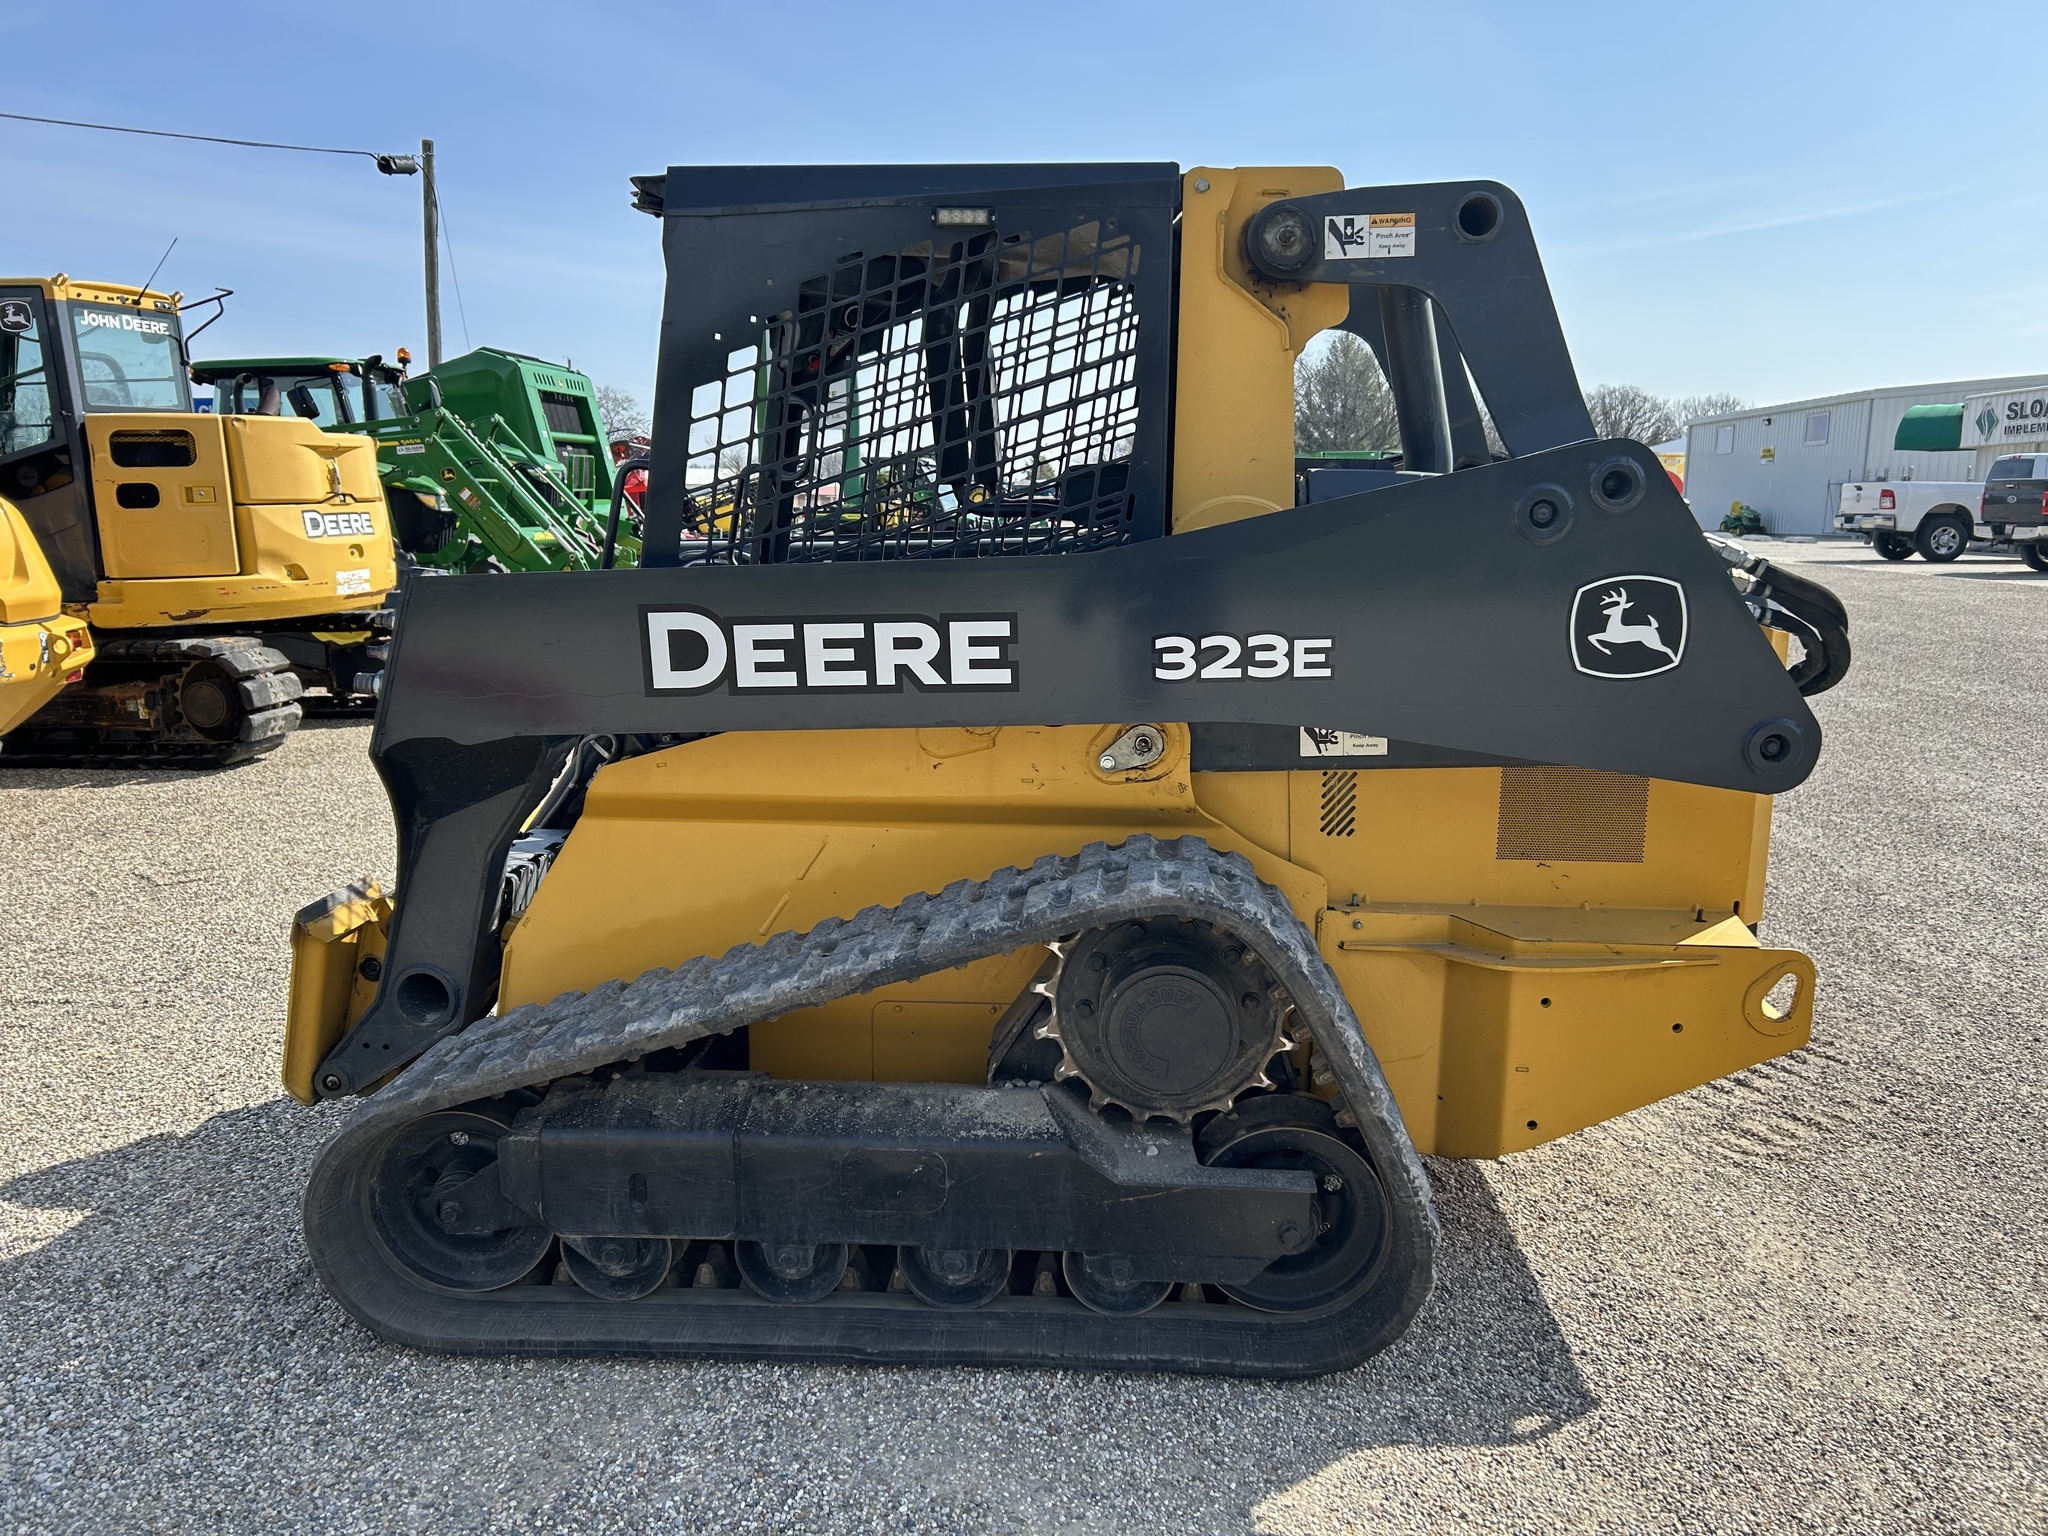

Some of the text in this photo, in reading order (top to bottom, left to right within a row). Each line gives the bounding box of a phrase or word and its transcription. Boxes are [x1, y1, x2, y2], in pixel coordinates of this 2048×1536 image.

[1378, 217, 1412, 225] WARNING
[81, 309, 170, 336] JOHN DEERE
[2003, 422, 2048, 436] IMPLEM
[303, 511, 374, 537] DEERE
[647, 611, 1012, 689] DEERE
[1155, 634, 1332, 680] 323E
